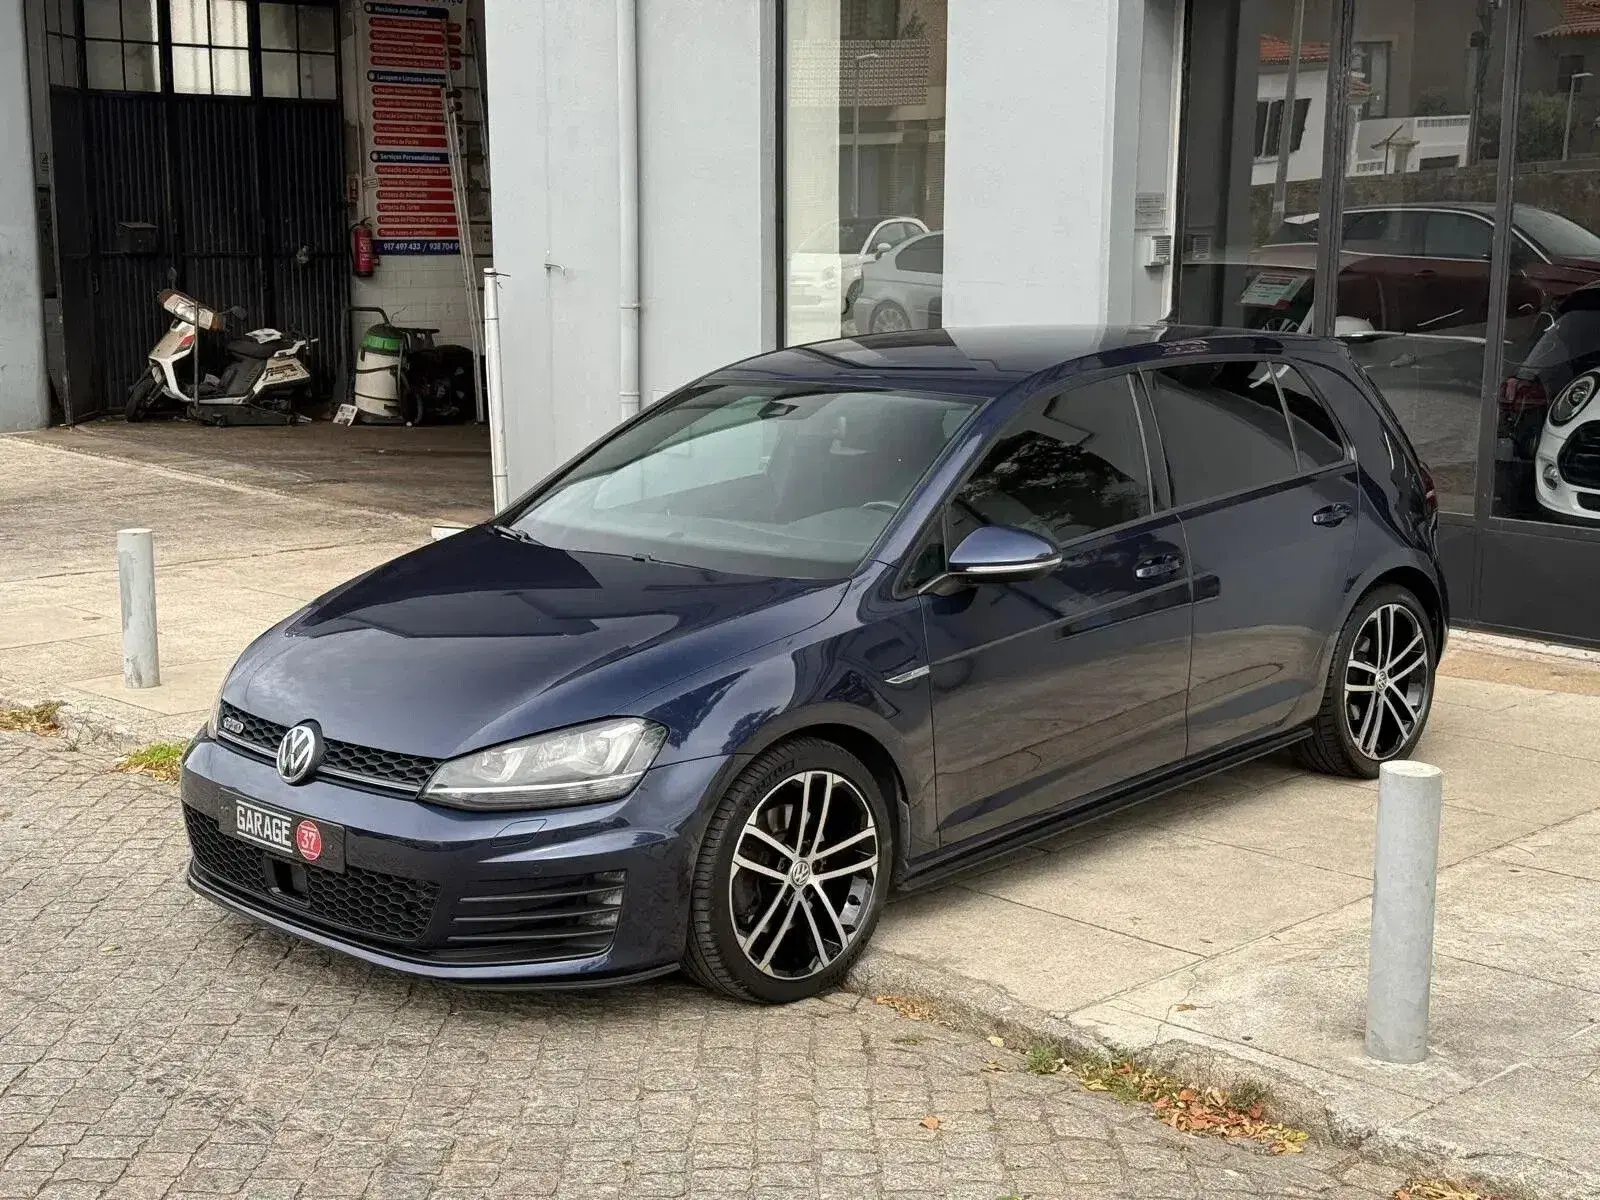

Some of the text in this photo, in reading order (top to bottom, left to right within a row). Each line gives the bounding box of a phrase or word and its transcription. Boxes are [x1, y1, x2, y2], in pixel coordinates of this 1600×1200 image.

[380, 153, 402, 161] Serviços
[383, 242, 394, 251] 917
[395, 242, 408, 251] 497
[442, 243, 453, 251] 704
[236, 804, 293, 848] GARAGE
[301, 829, 317, 851] 37
